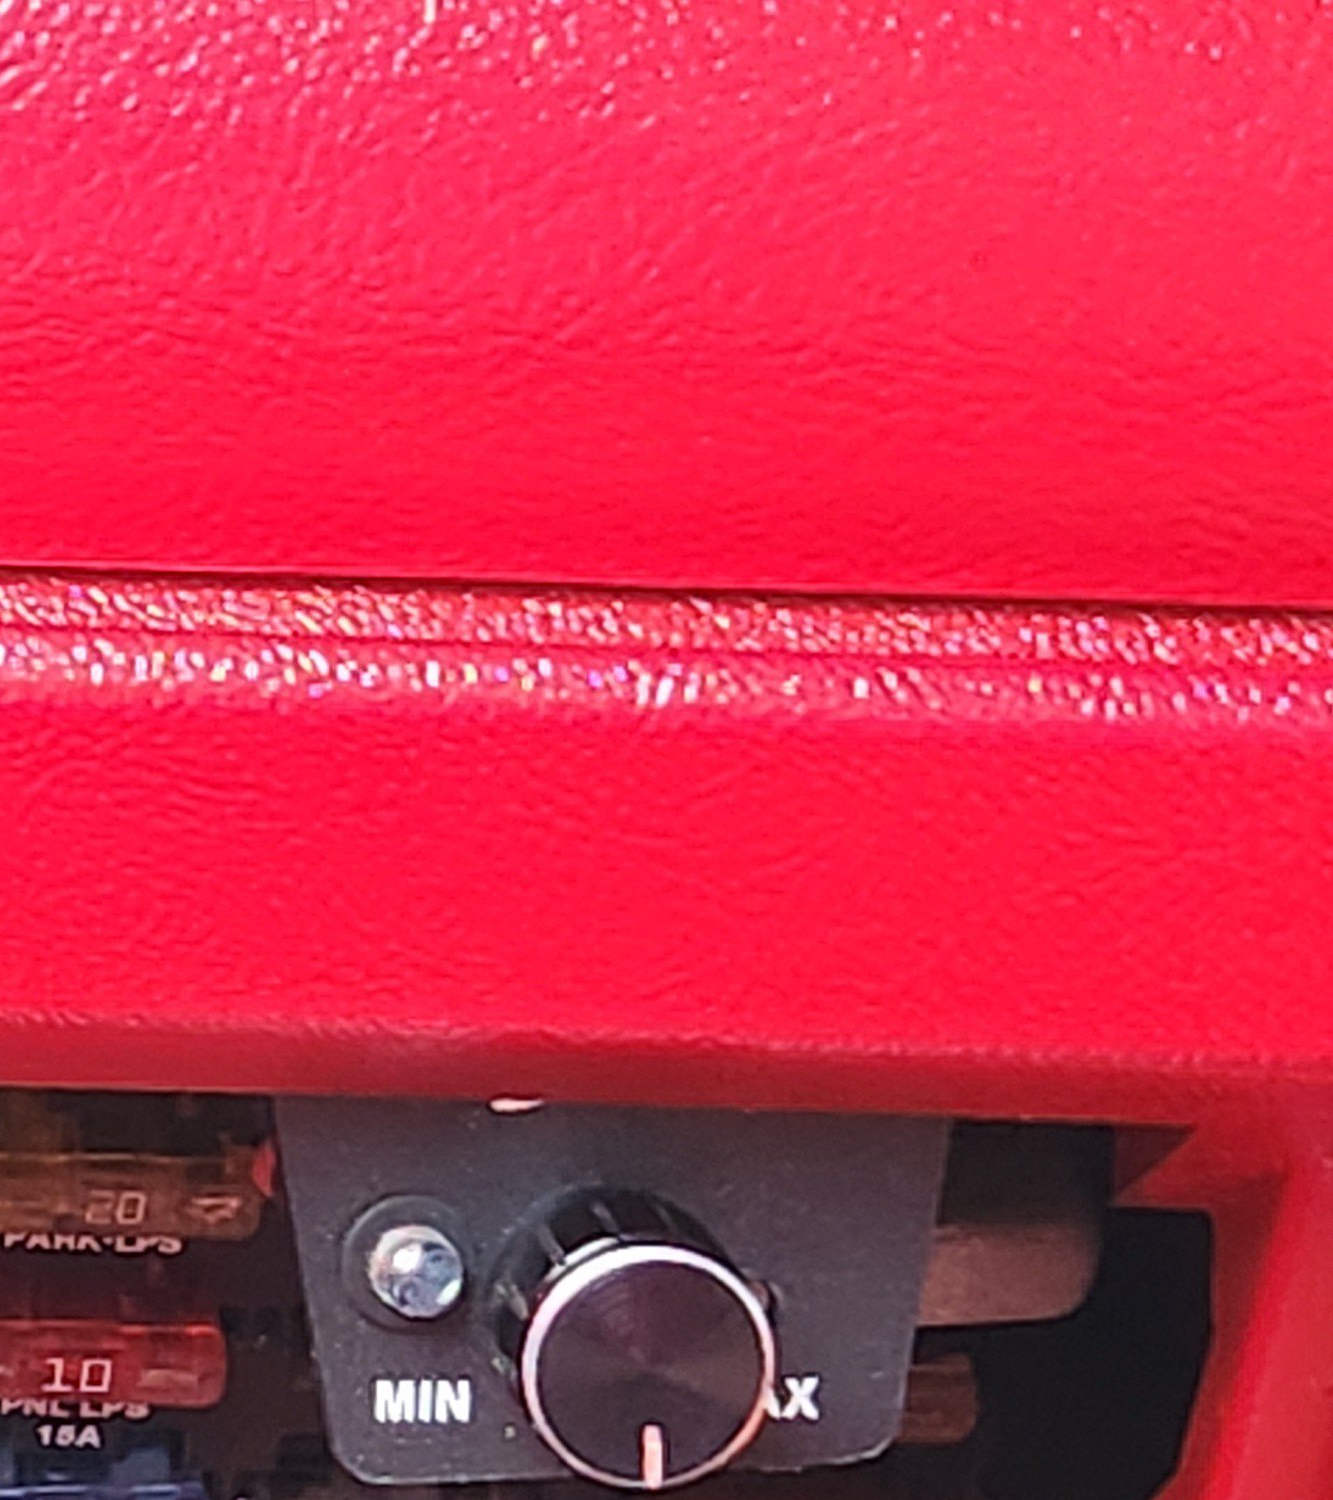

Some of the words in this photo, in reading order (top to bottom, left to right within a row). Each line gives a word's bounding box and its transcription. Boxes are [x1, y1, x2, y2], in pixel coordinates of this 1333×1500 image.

[85, 1189, 147, 1225] 20
[40, 1356, 113, 1393] 10
[373, 1377, 472, 1424] MIN
